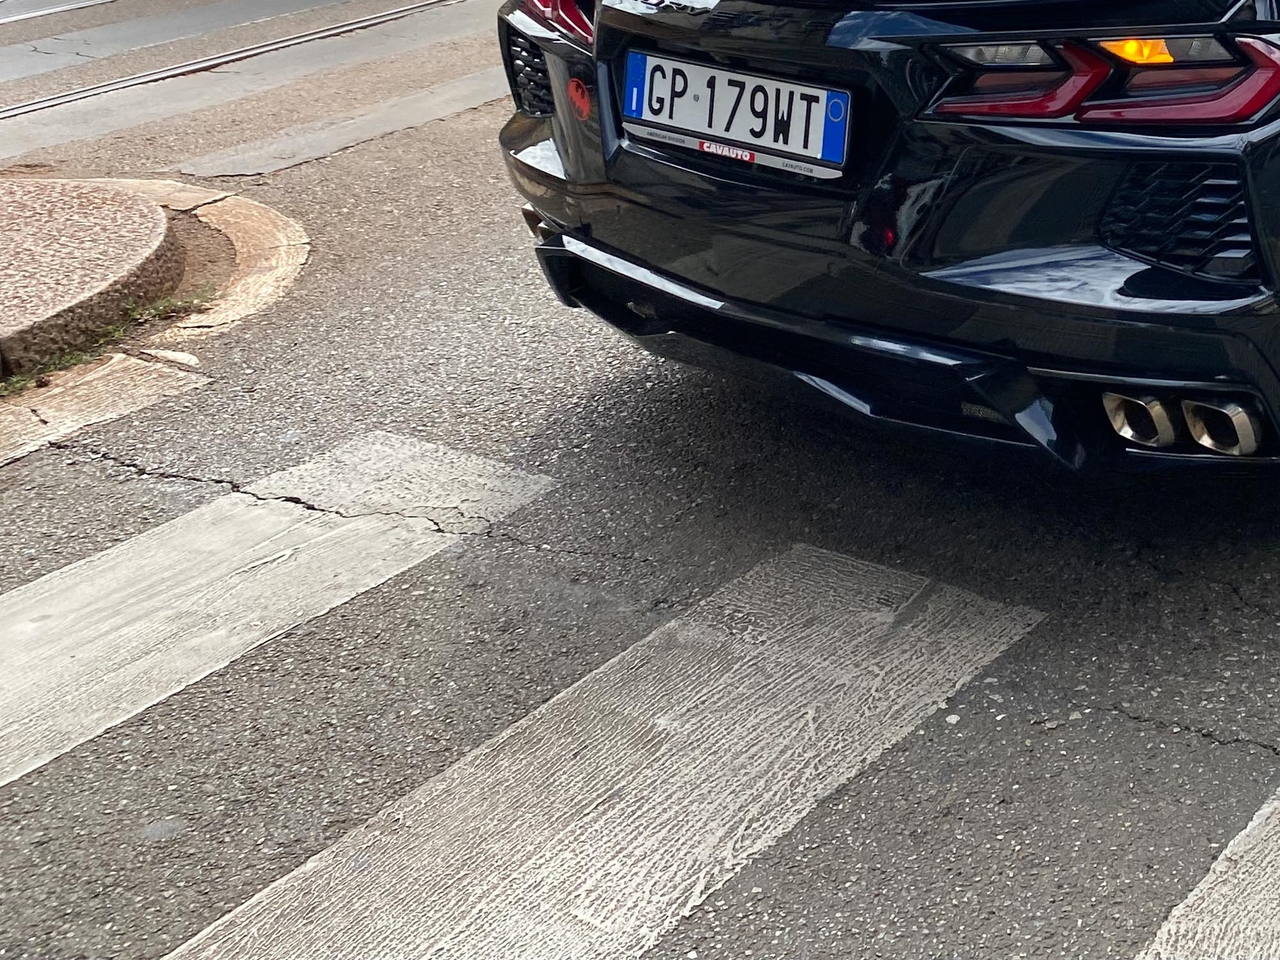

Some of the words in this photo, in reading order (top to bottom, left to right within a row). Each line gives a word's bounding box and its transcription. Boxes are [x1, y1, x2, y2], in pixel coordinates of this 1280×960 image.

[647, 64, 688, 120] GP
[706, 75, 820, 150] 179WT
[646, 131, 668, 141] AMERICAN
[703, 143, 751, 160] CAVAUTO
[782, 161, 814, 174] CAVAUTO.COM
